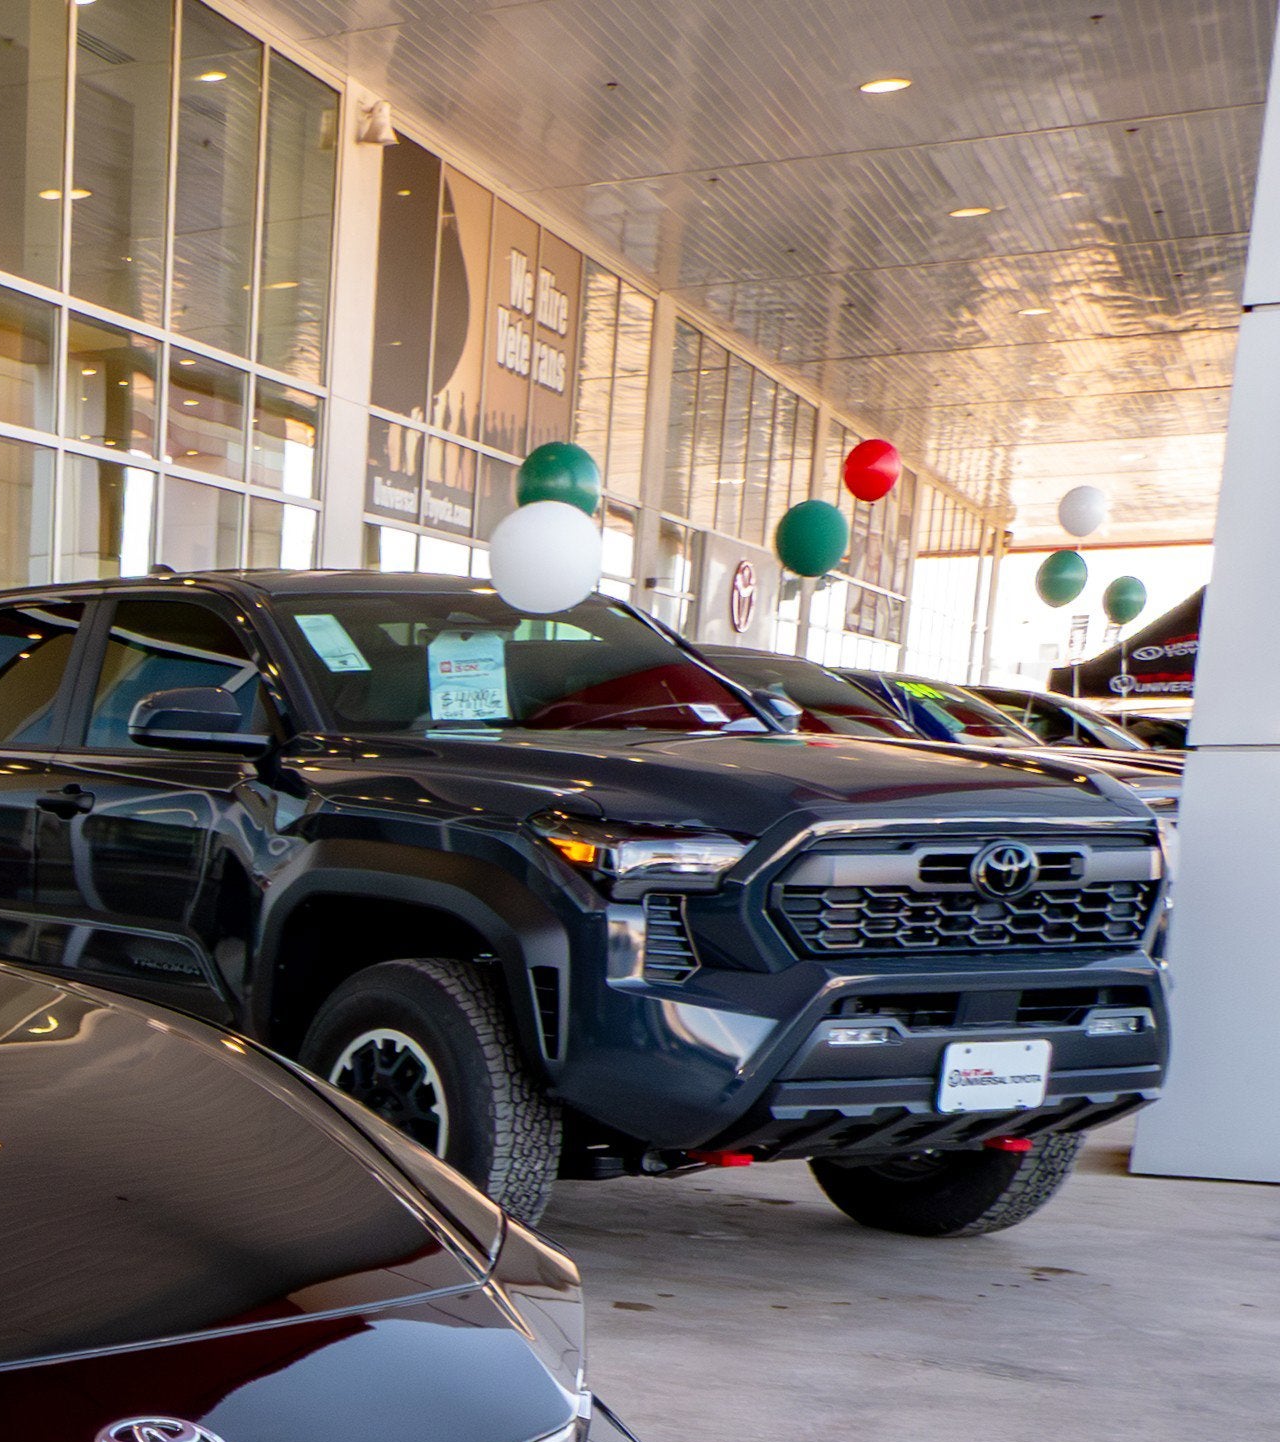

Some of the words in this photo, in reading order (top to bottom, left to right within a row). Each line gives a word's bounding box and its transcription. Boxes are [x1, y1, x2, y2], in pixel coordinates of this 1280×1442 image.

[510, 248, 534, 315] We
[536, 267, 569, 335] Hire
[962, 1076, 1007, 1086] UNIVERSAL
[1010, 1074, 1041, 1084] TOYOTA
